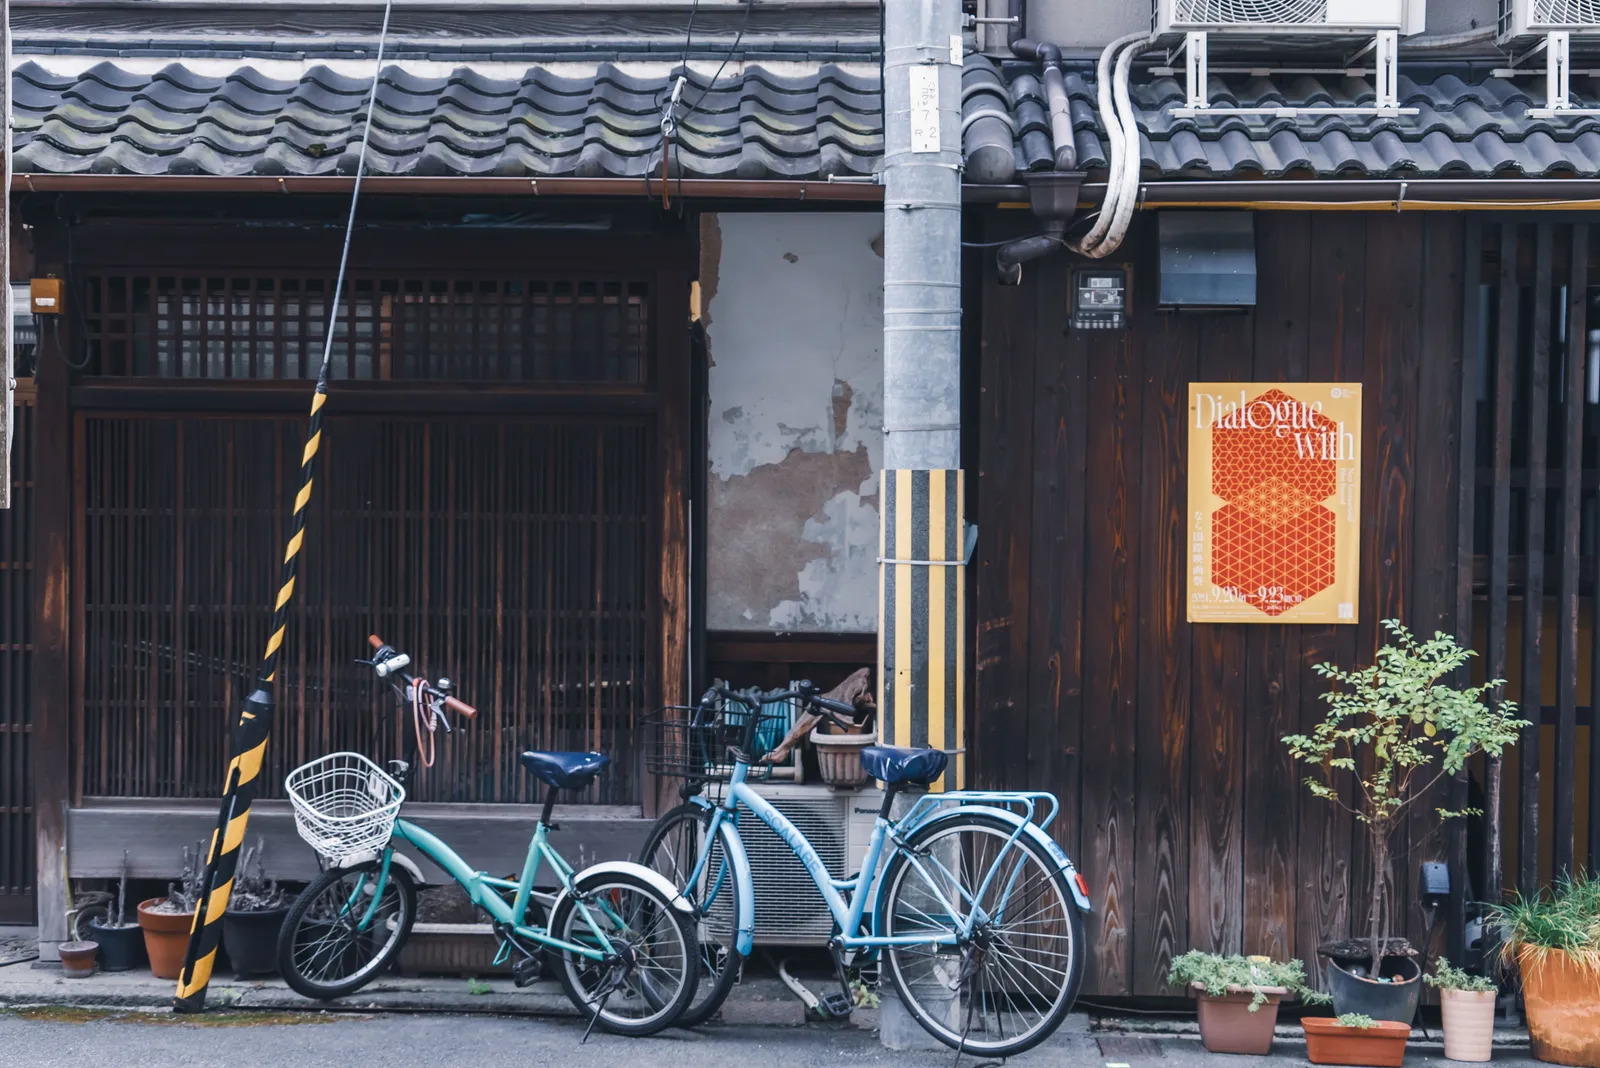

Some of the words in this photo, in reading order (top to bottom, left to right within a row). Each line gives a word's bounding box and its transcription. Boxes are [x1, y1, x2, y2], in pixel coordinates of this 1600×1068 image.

[921, 109, 930, 120] 7
[914, 129, 923, 137] R
[929, 126, 937, 139] 2
[1195, 390, 1323, 438] Dialogue
[1294, 421, 1355, 461] with
